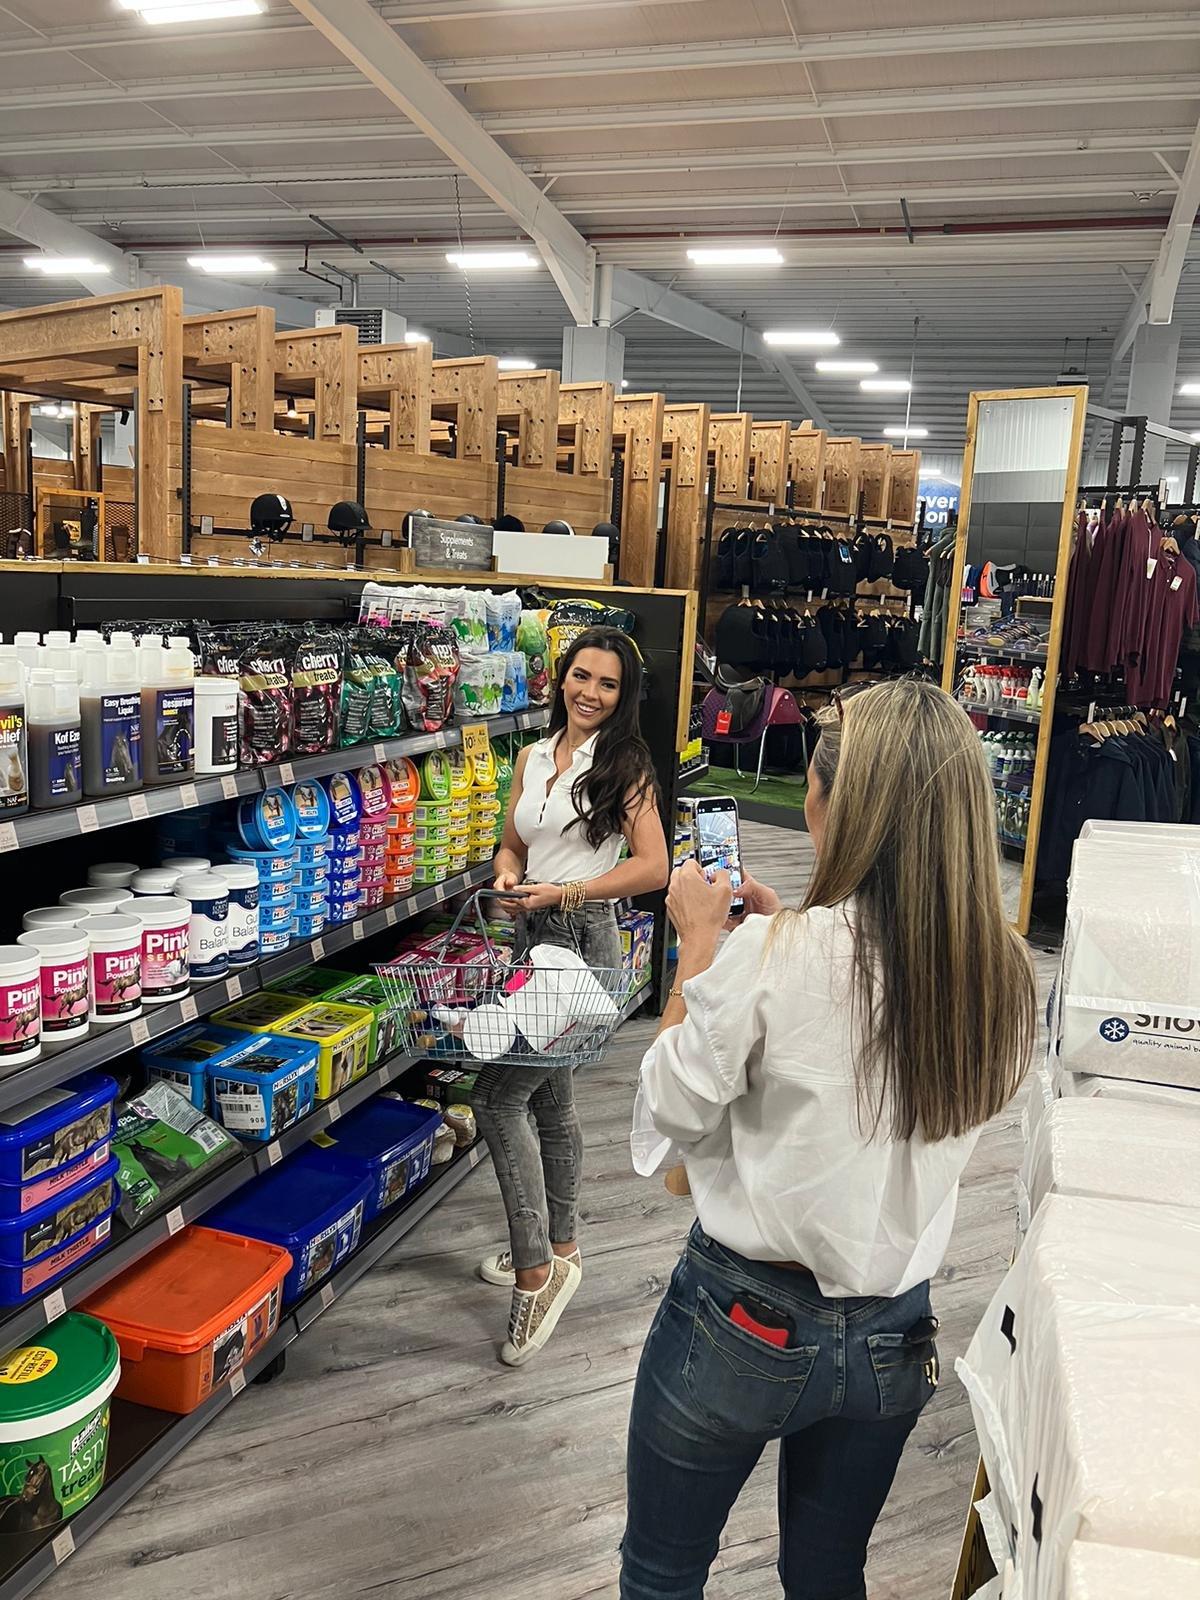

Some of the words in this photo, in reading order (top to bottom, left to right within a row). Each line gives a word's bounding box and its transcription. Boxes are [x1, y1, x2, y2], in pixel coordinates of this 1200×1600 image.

[440, 532, 474, 547] Supplements
[445, 547, 451, 559] &
[452, 548, 468, 560] Treats
[250, 658, 285, 674] cherry
[302, 653, 338, 669] cherry
[313, 669, 337, 682] treats
[104, 699, 120, 708] Easy
[117, 706, 134, 716] Liquid
[55, 731, 69, 745] Kof
[69, 730, 80, 742] Eze
[146, 929, 189, 954] Pink
[105, 952, 141, 973] Pink
[53, 966, 88, 987] Pink
[1132, 1039, 1162, 1049] quality
[1164, 1043, 1191, 1051] animal
[49, 1171, 65, 1185] MILK
[66, 1159, 89, 1177] THISTLE
[50, 1252, 66, 1266] MILK
[66, 1236, 89, 1256] THISTLE
[58, 1431, 107, 1484] TASTY
